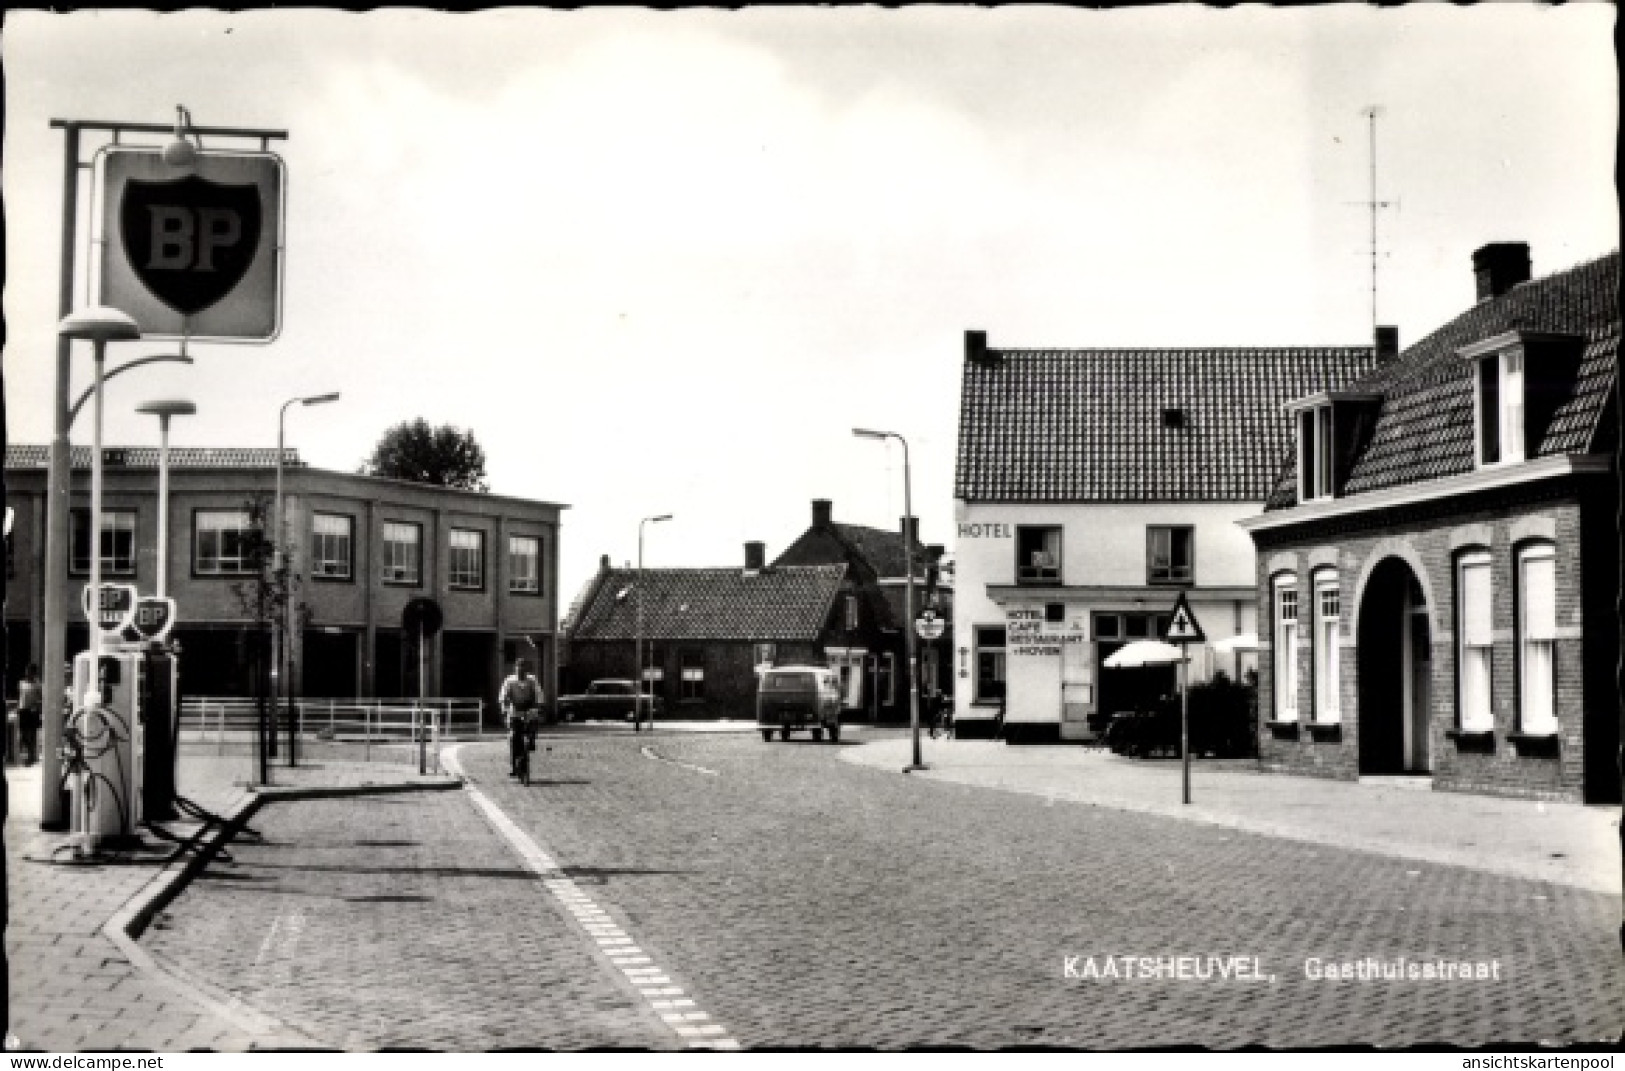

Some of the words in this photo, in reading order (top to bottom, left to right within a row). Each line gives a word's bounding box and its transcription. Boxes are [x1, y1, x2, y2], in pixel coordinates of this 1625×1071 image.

[144, 204, 241, 271] BP
[957, 523, 1012, 538] HOTEL
[140, 608, 164, 625] BP
[1008, 610, 1042, 620] HOTEL
